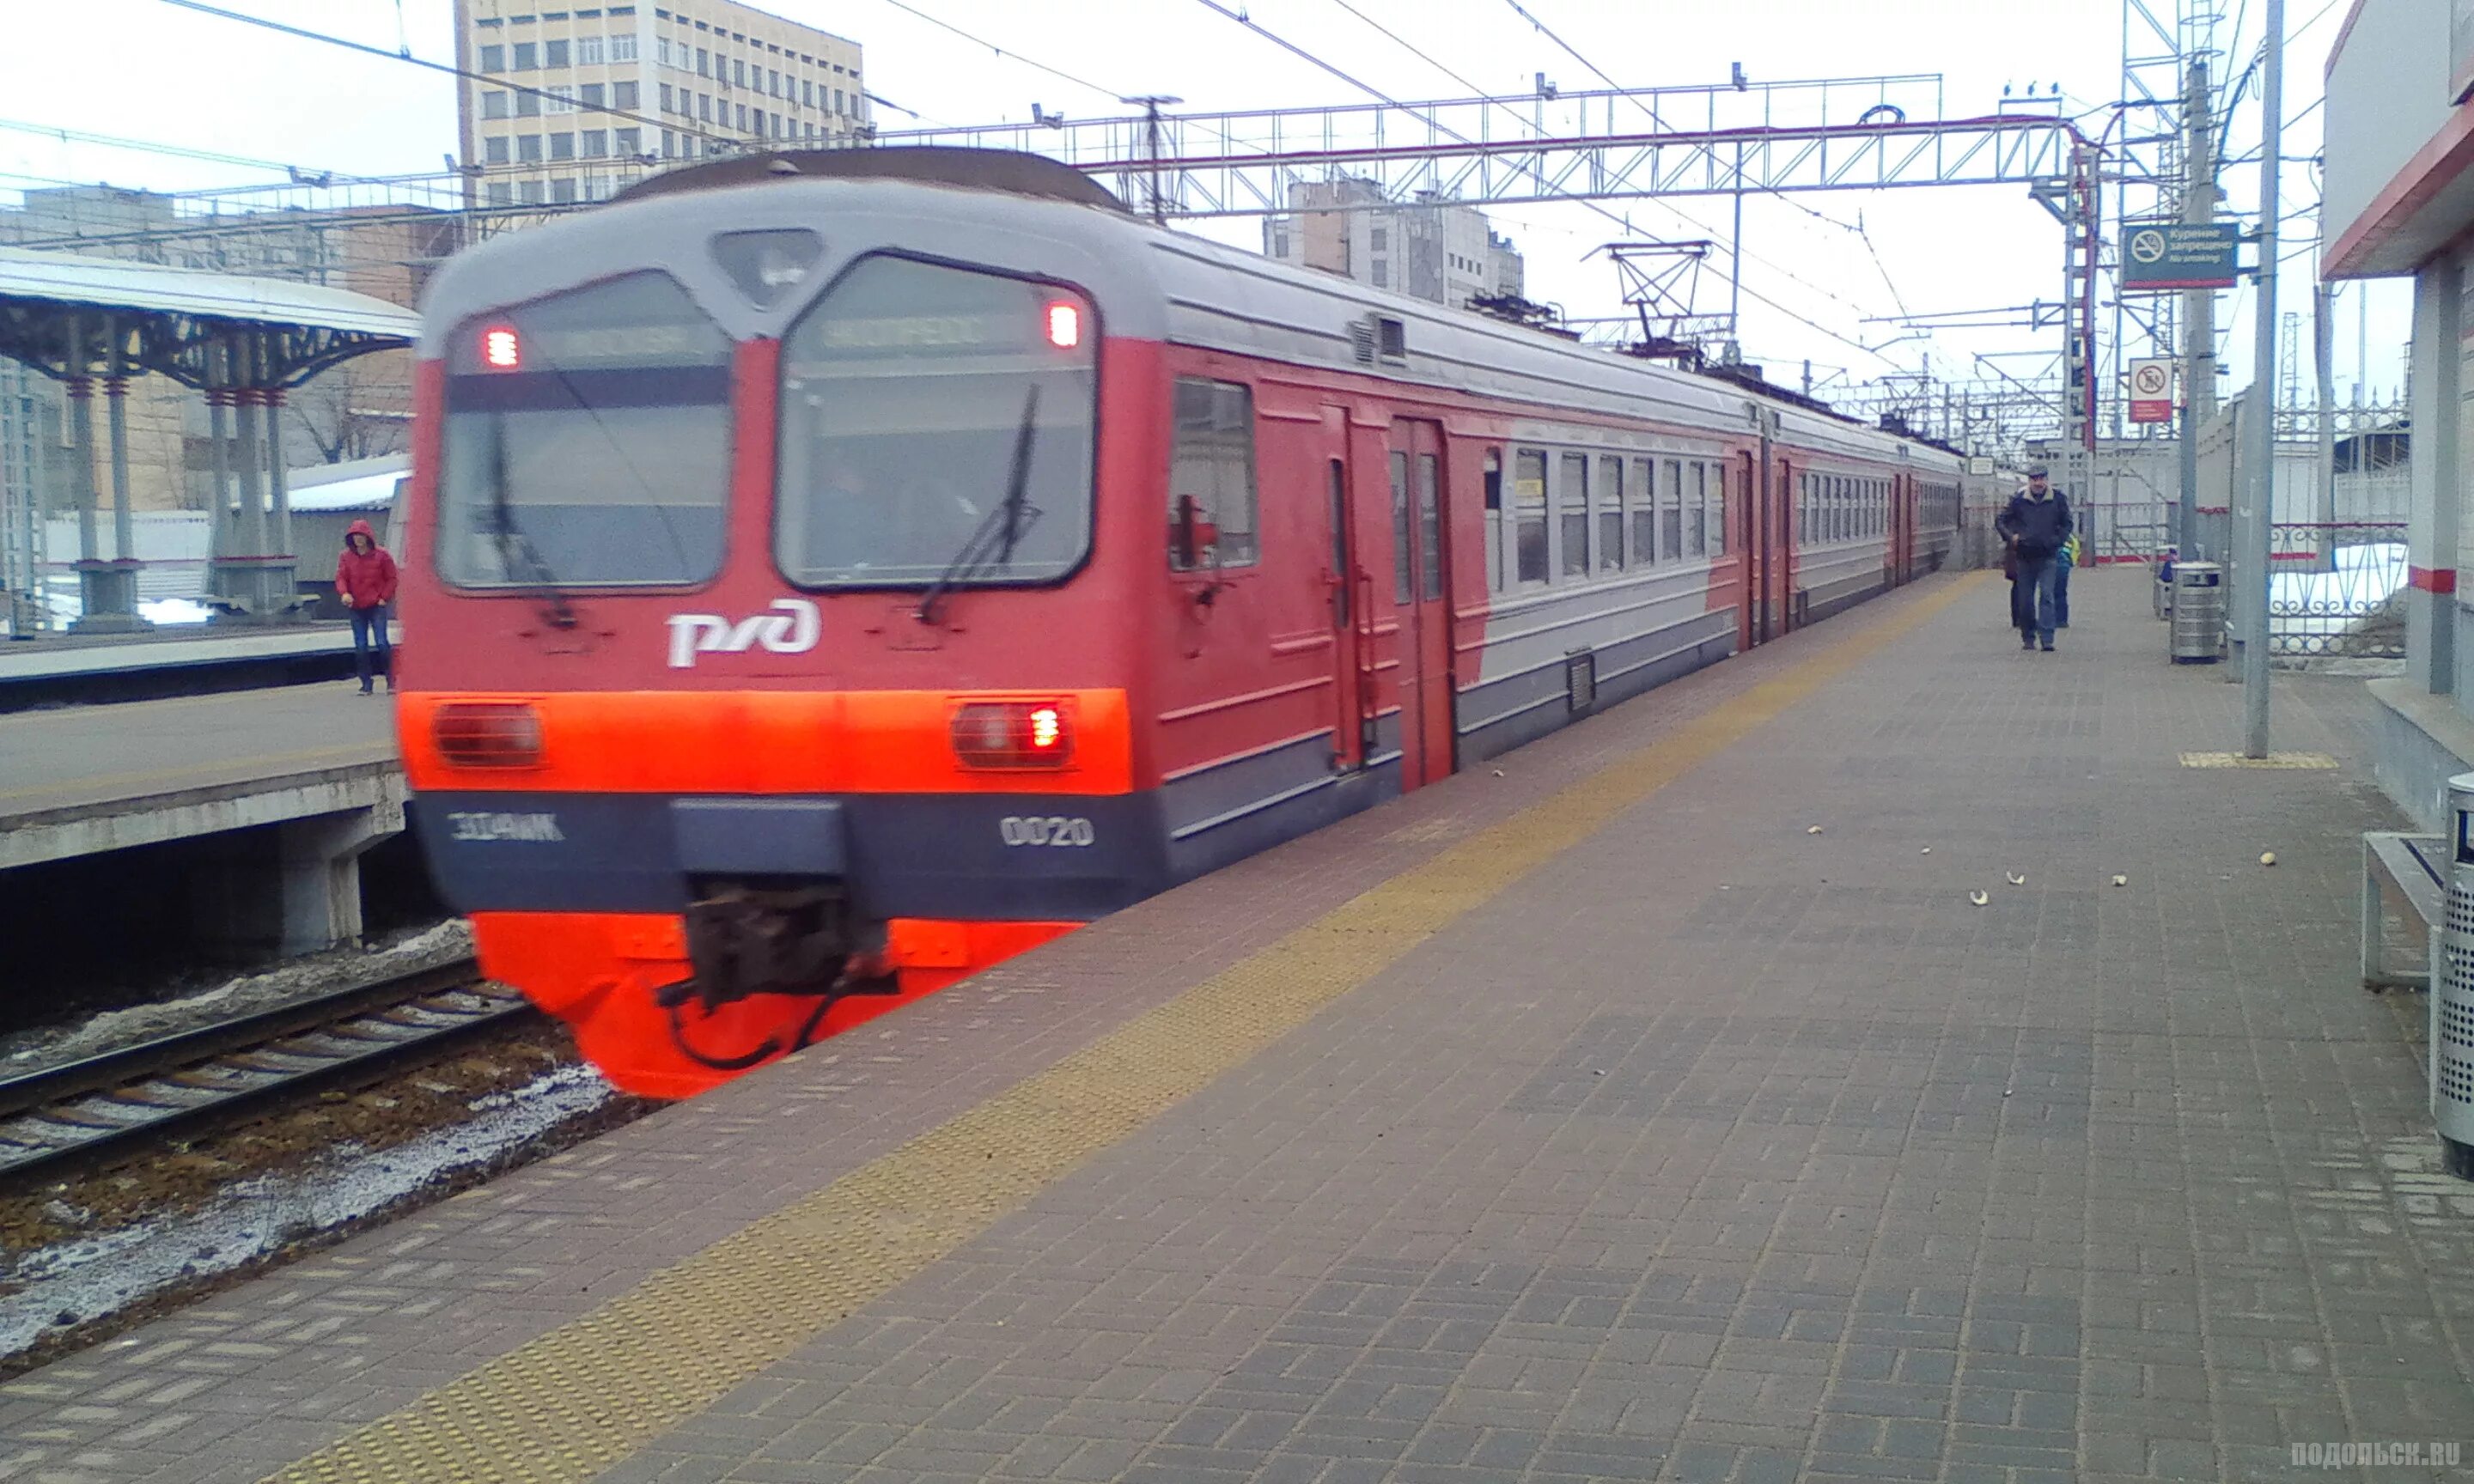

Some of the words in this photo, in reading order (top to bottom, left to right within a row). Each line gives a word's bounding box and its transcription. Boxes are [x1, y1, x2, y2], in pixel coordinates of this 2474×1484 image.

[2170, 228, 2221, 240] Курение
[2171, 241, 2232, 252] запрещено
[1000, 816, 1095, 846] 0020
